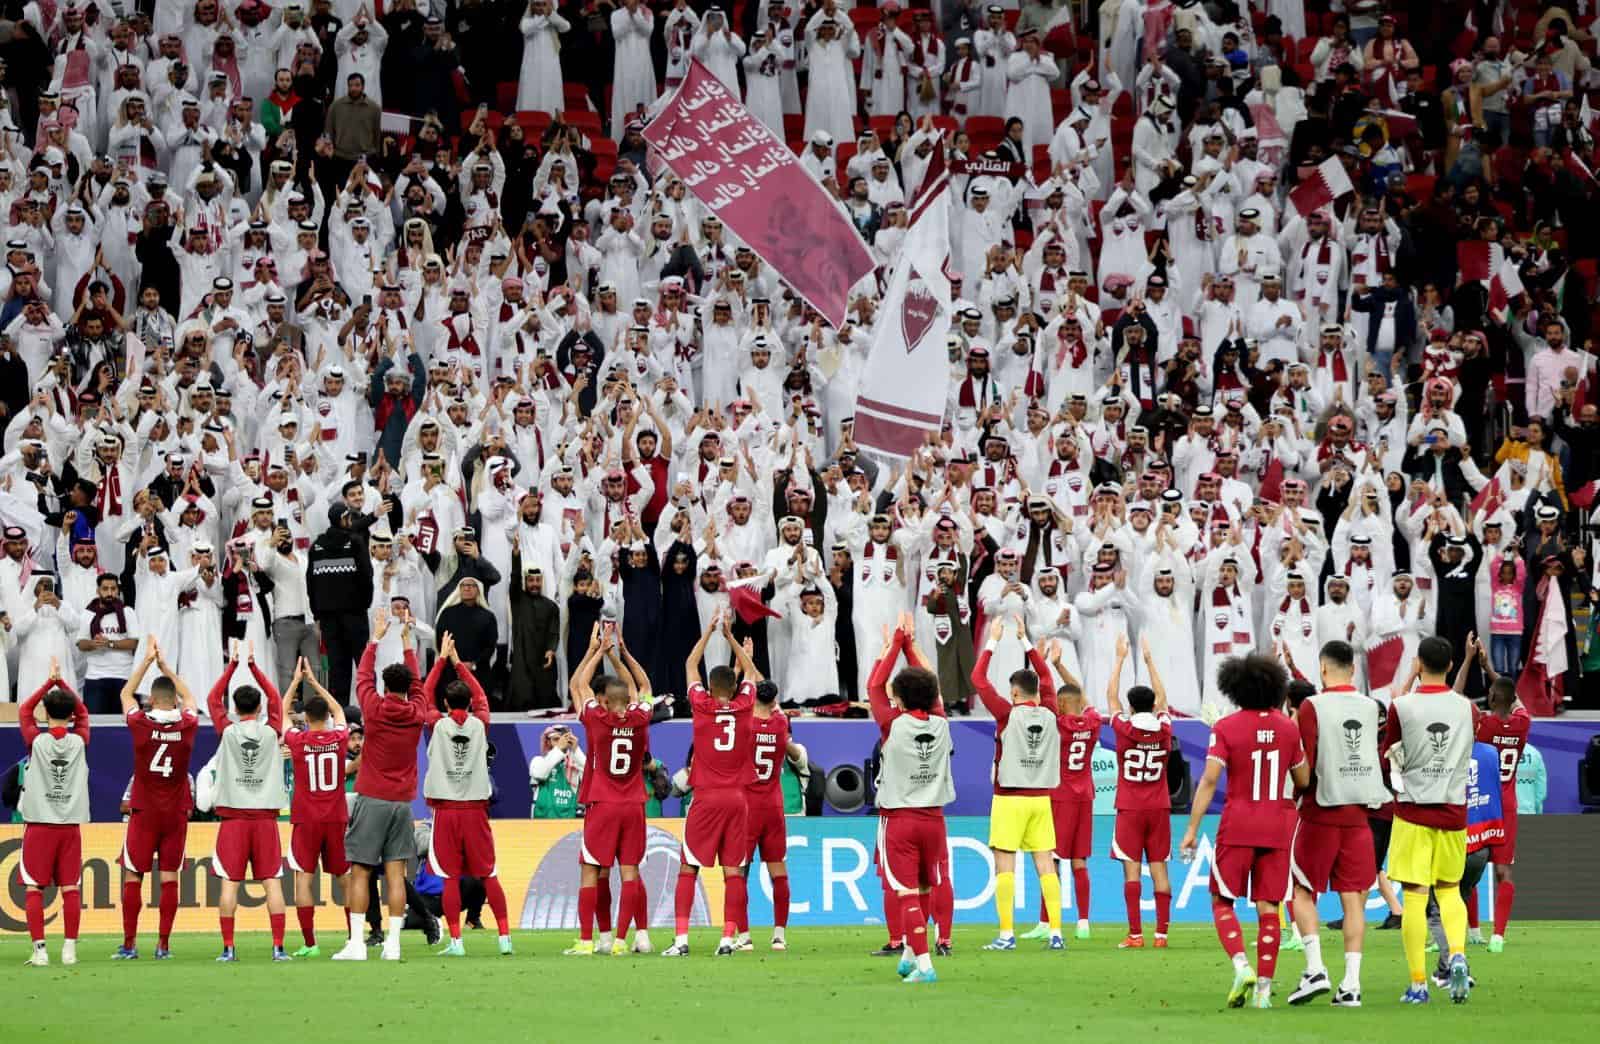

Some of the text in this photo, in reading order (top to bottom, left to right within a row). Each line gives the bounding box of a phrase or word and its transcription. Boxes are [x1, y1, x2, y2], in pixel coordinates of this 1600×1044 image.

[713, 714, 736, 751] 3
[149, 743, 173, 777] 4
[305, 752, 338, 792] 10
[610, 738, 633, 775] 6
[754, 745, 776, 780] 5
[1068, 741, 1087, 771] 2
[1123, 749, 1168, 782] 25
[1500, 748, 1519, 782] 9
[1251, 749, 1280, 801] 11
[1466, 834, 1480, 844] AM
